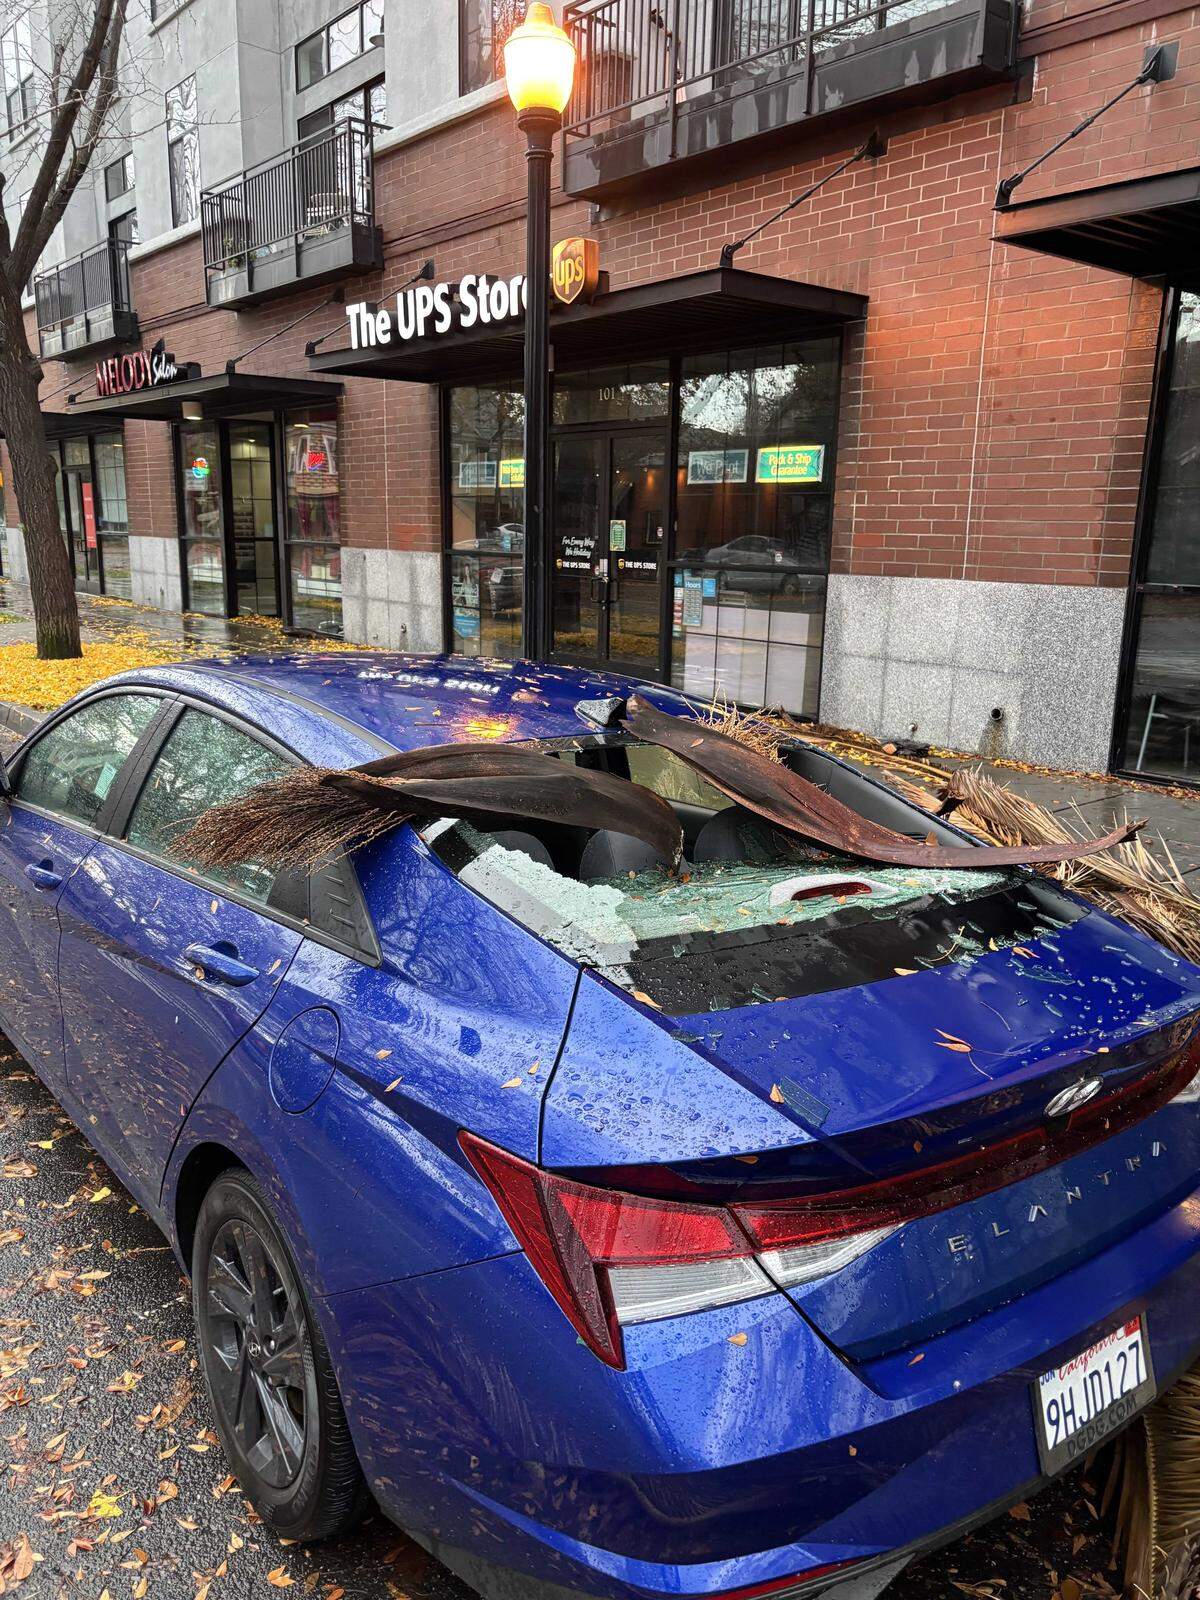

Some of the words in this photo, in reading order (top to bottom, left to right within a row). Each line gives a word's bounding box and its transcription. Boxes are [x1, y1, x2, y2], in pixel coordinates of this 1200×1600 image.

[555, 255, 583, 294] ups
[346, 302, 391, 350] The
[397, 283, 452, 340] UPS
[96, 349, 153, 396] MELODY
[152, 353, 178, 385] Salon
[599, 387, 615, 401] 101
[633, 561, 642, 569] UPS
[643, 562, 657, 570] STORE
[948, 1141, 1167, 1253] ELANTRA
[1046, 1340, 1141, 1449] 9HJD127
